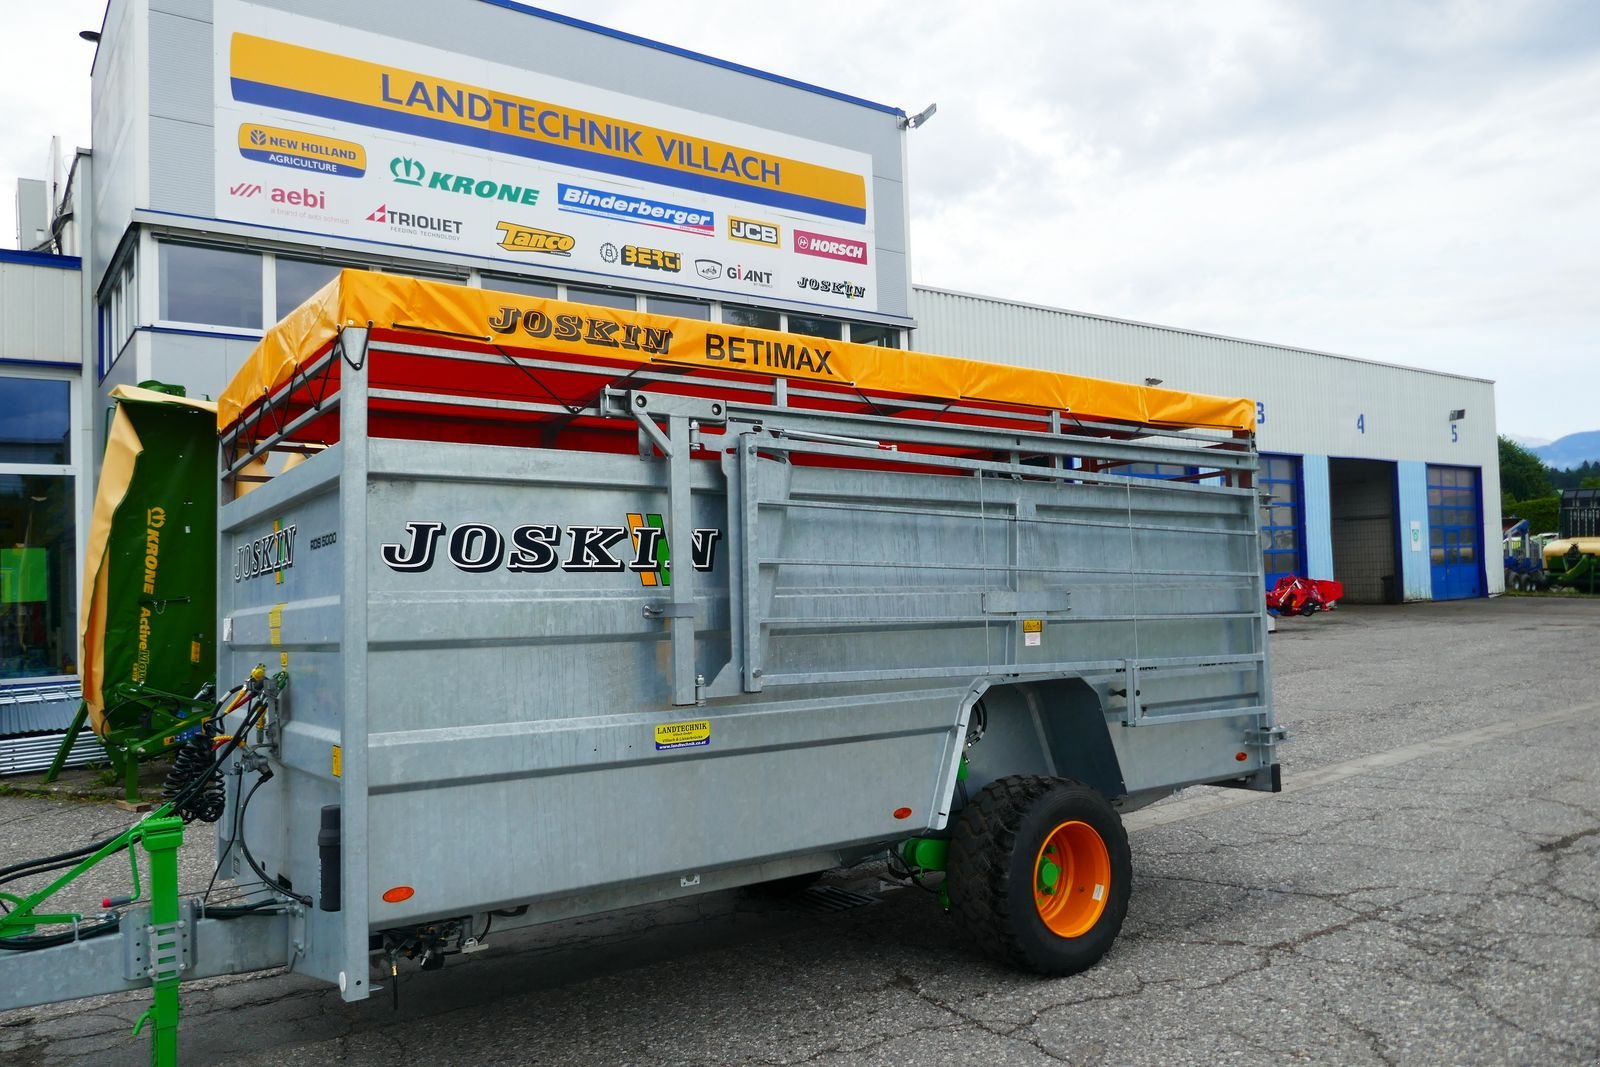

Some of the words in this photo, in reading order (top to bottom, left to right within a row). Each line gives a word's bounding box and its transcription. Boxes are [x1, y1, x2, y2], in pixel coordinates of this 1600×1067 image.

[381, 73, 643, 156] LANDTECHNIK
[656, 135, 781, 185] VILLACH
[269, 136, 298, 151] NEW
[301, 142, 357, 161] HOLLAND
[268, 153, 338, 173] AGRICULTURE
[271, 188, 325, 209] aebi
[428, 172, 541, 206] KRONE
[563, 187, 711, 226] Binderberger
[387, 210, 463, 234] TRIOLIET
[390, 226, 418, 236] FEEDING
[420, 231, 461, 241] TECHNOLOGY
[731, 222, 777, 243] JCB
[496, 221, 576, 252] Tanco
[810, 238, 863, 259] HORSCH
[797, 276, 866, 299] JOSKIN
[488, 306, 674, 355] JOSKIN
[705, 333, 833, 375] BETIMAX
[1257, 401, 1265, 424] 3
[1356, 413, 1365, 435] 4
[1451, 424, 1458, 443] 5
[322, 531, 337, 547] 5000
[380, 520, 722, 573] JOSKIN
[143, 528, 160, 595] KRONE
[234, 524, 297, 583] JOSKIN
[657, 722, 707, 735] LANDTECHNIK
